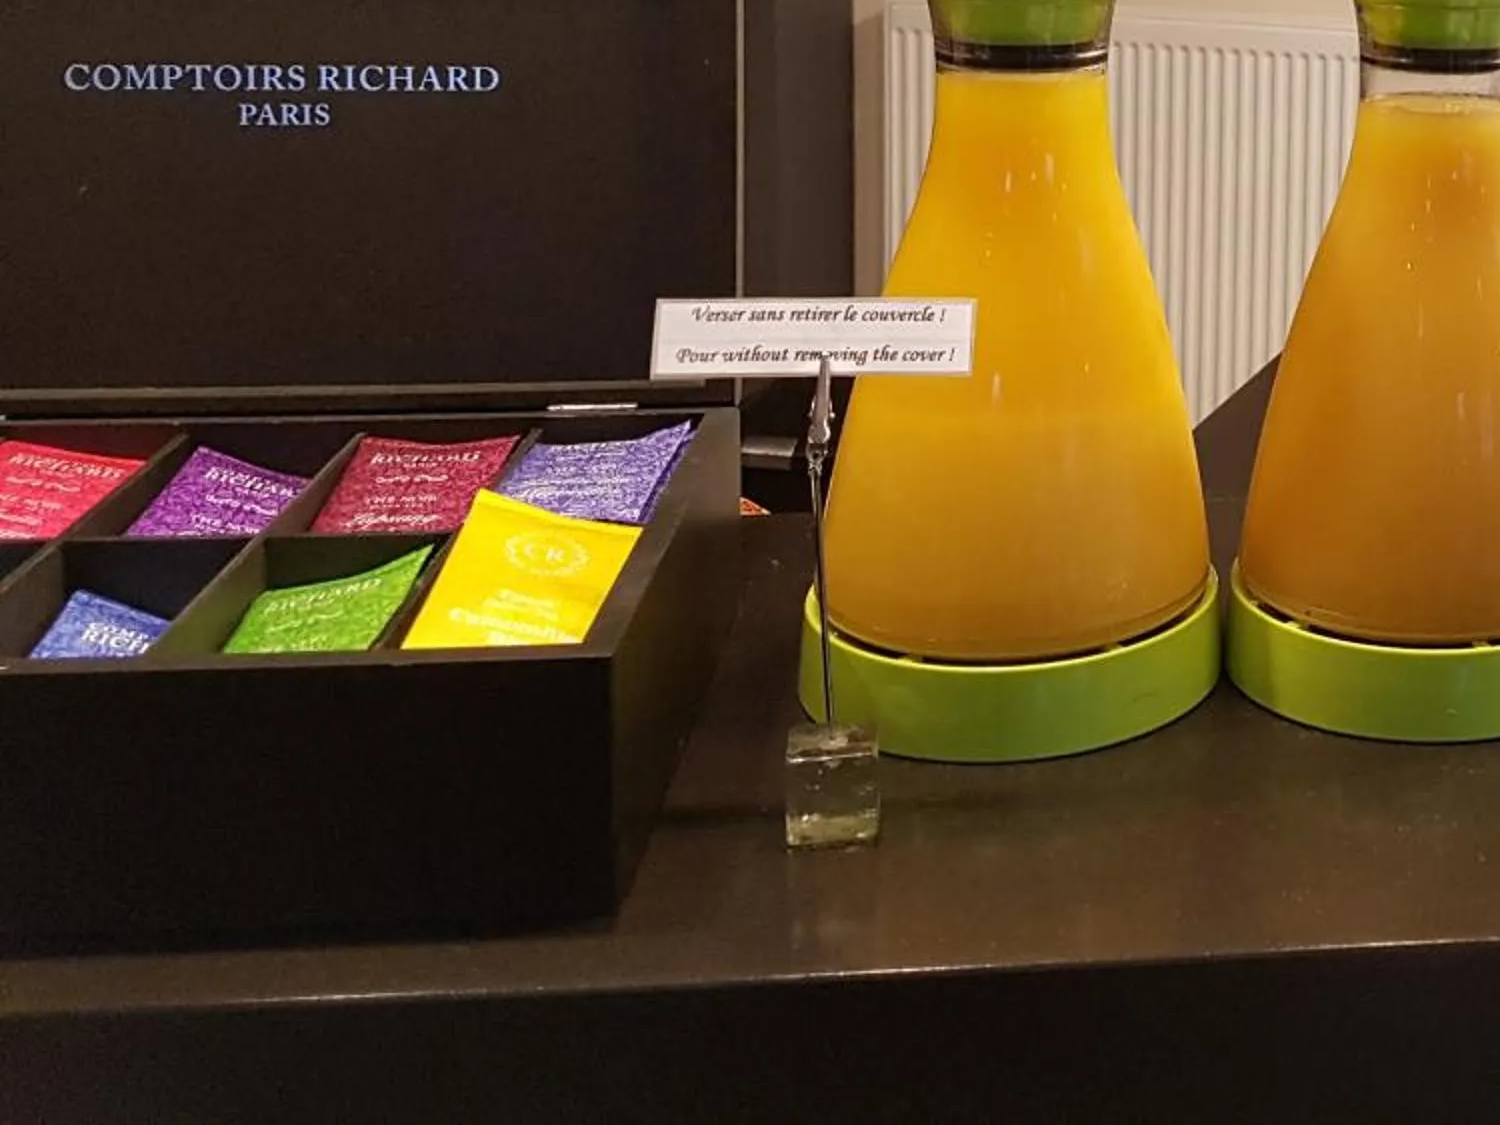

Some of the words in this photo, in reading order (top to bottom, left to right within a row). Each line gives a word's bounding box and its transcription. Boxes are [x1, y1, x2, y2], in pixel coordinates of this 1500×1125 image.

[64, 63, 307, 92] COMPTOIRS
[318, 64, 500, 93] RICHARD
[239, 102, 331, 127] PARIS
[691, 304, 743, 323] Verser
[748, 308, 785, 322] sans
[789, 306, 839, 322] retirer
[844, 304, 857, 322] le
[861, 305, 935, 322] couvercle
[676, 347, 717, 363] Pour
[721, 344, 789, 362] without
[873, 344, 897, 362] the
[902, 348, 946, 362] cover
